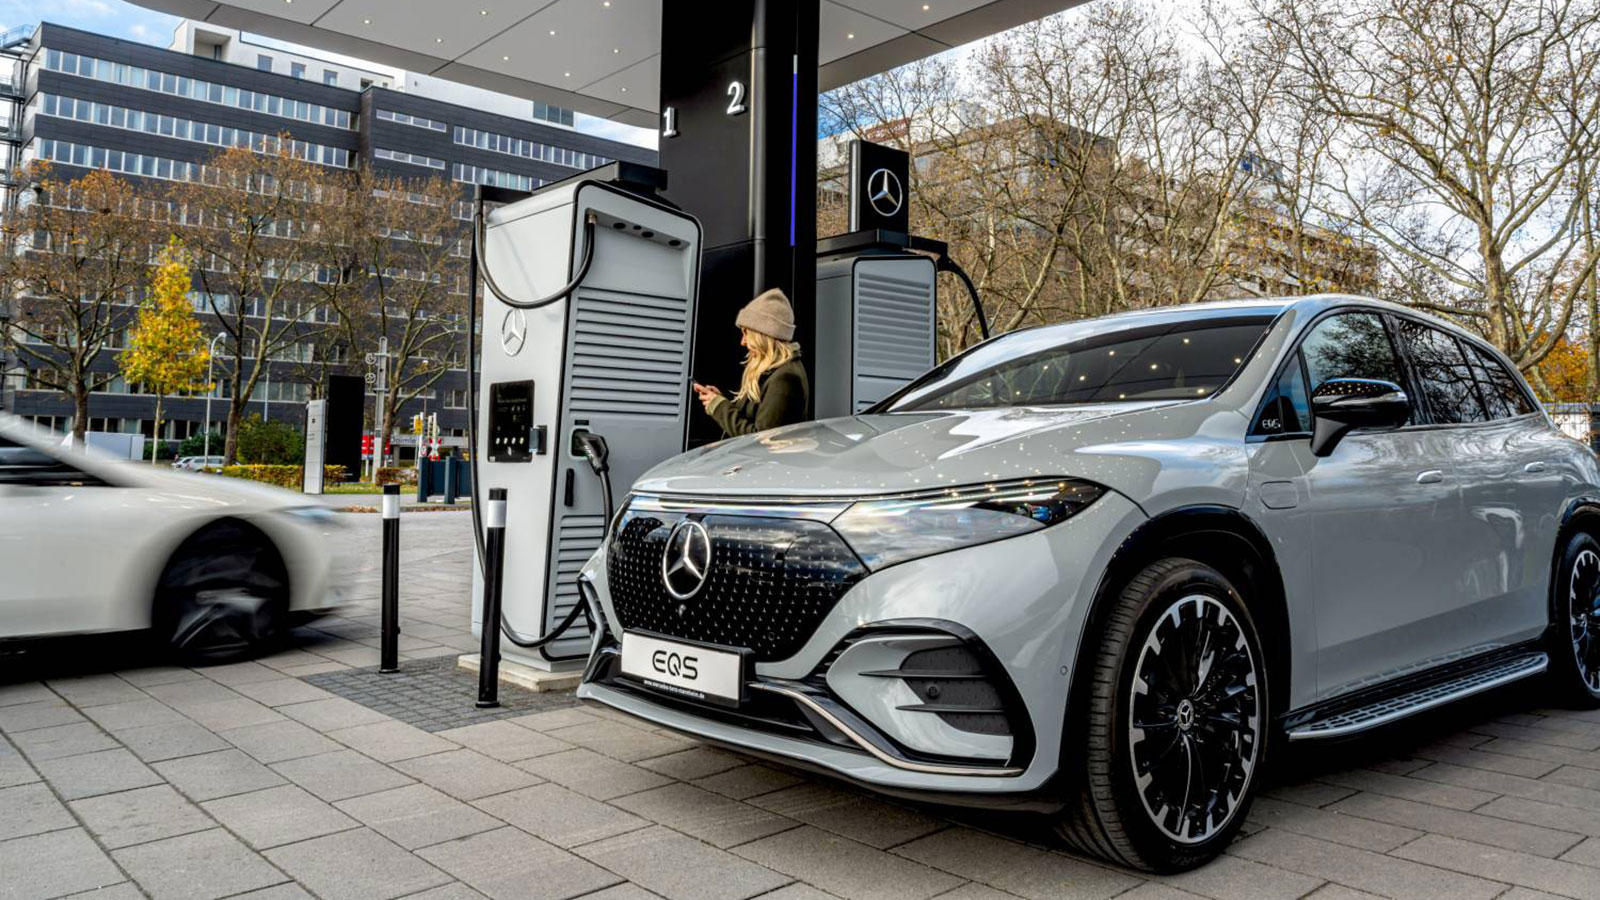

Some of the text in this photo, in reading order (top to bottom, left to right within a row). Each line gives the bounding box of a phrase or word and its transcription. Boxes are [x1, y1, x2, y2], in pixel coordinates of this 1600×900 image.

[727, 81, 745, 115] 2
[663, 107, 677, 137] 1
[1262, 418, 1281, 429] EQS
[652, 650, 698, 680] EQS
